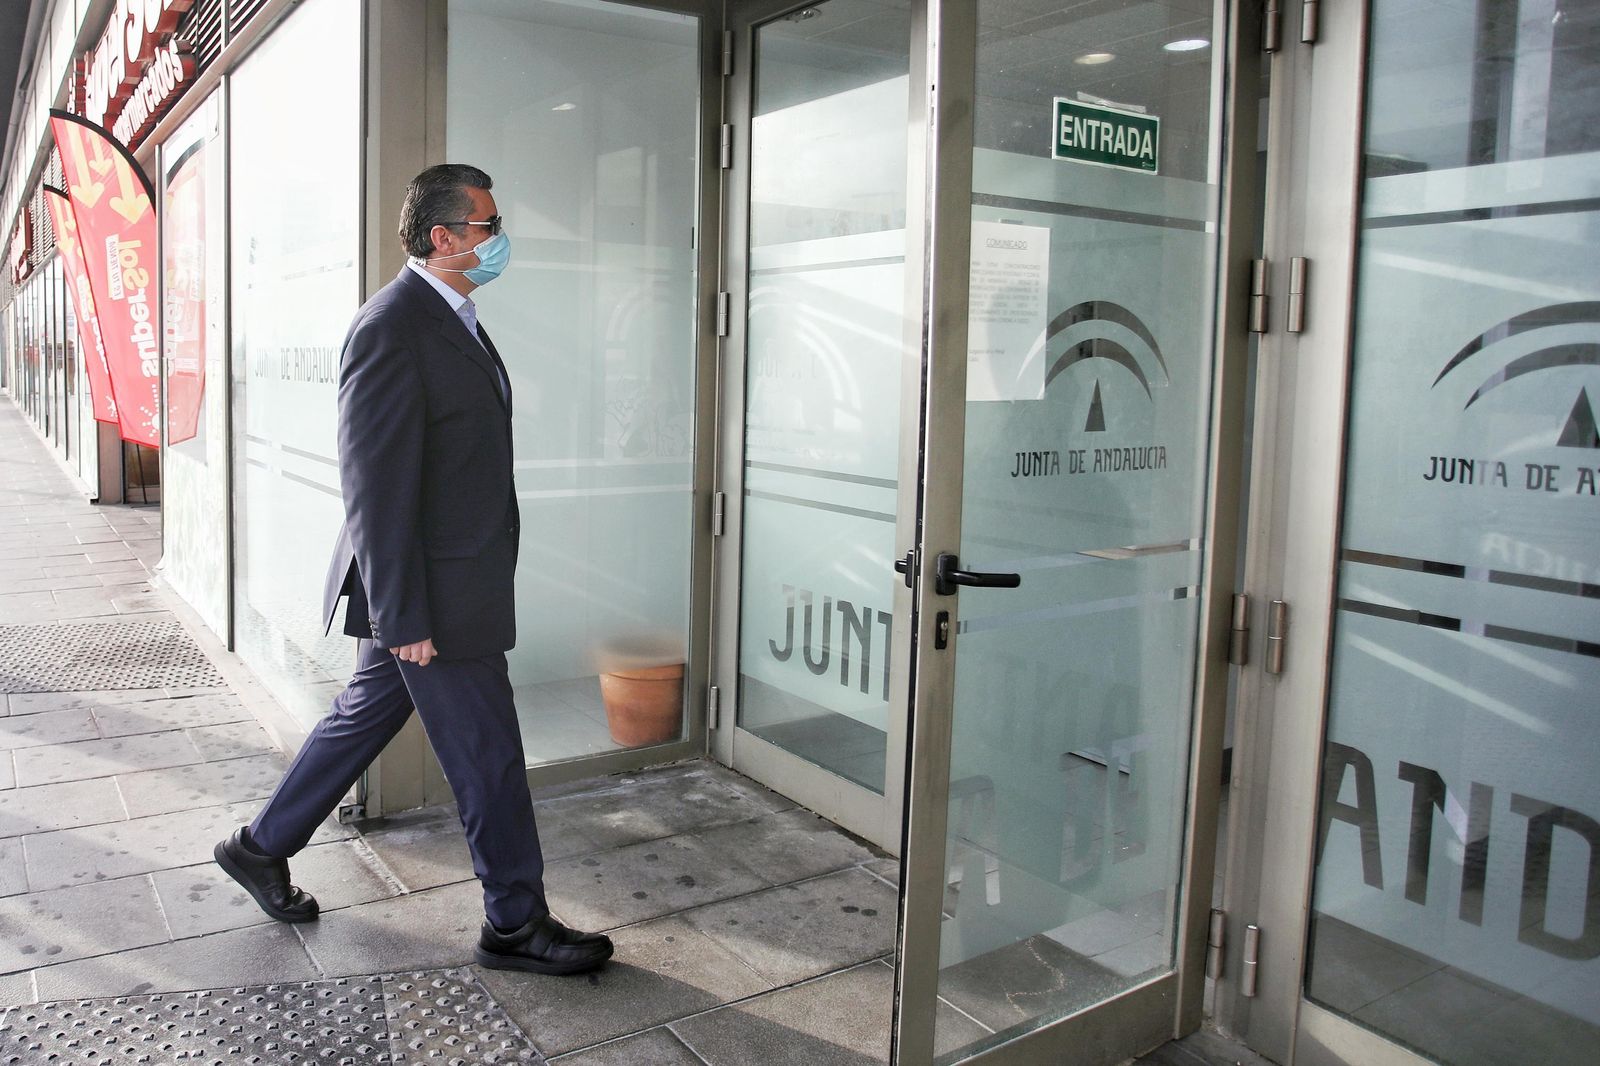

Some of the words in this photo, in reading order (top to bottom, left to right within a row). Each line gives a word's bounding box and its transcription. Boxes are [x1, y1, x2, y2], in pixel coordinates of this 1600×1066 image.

[1060, 114, 1153, 160] ENTRADA
[1011, 451, 1060, 477] JUNTA
[1069, 450, 1086, 474] DE
[1093, 446, 1167, 473] ANDALUCIA
[1423, 456, 1508, 488] JUNTA
[1525, 463, 1560, 492] DE
[1576, 467, 1600, 496] A
